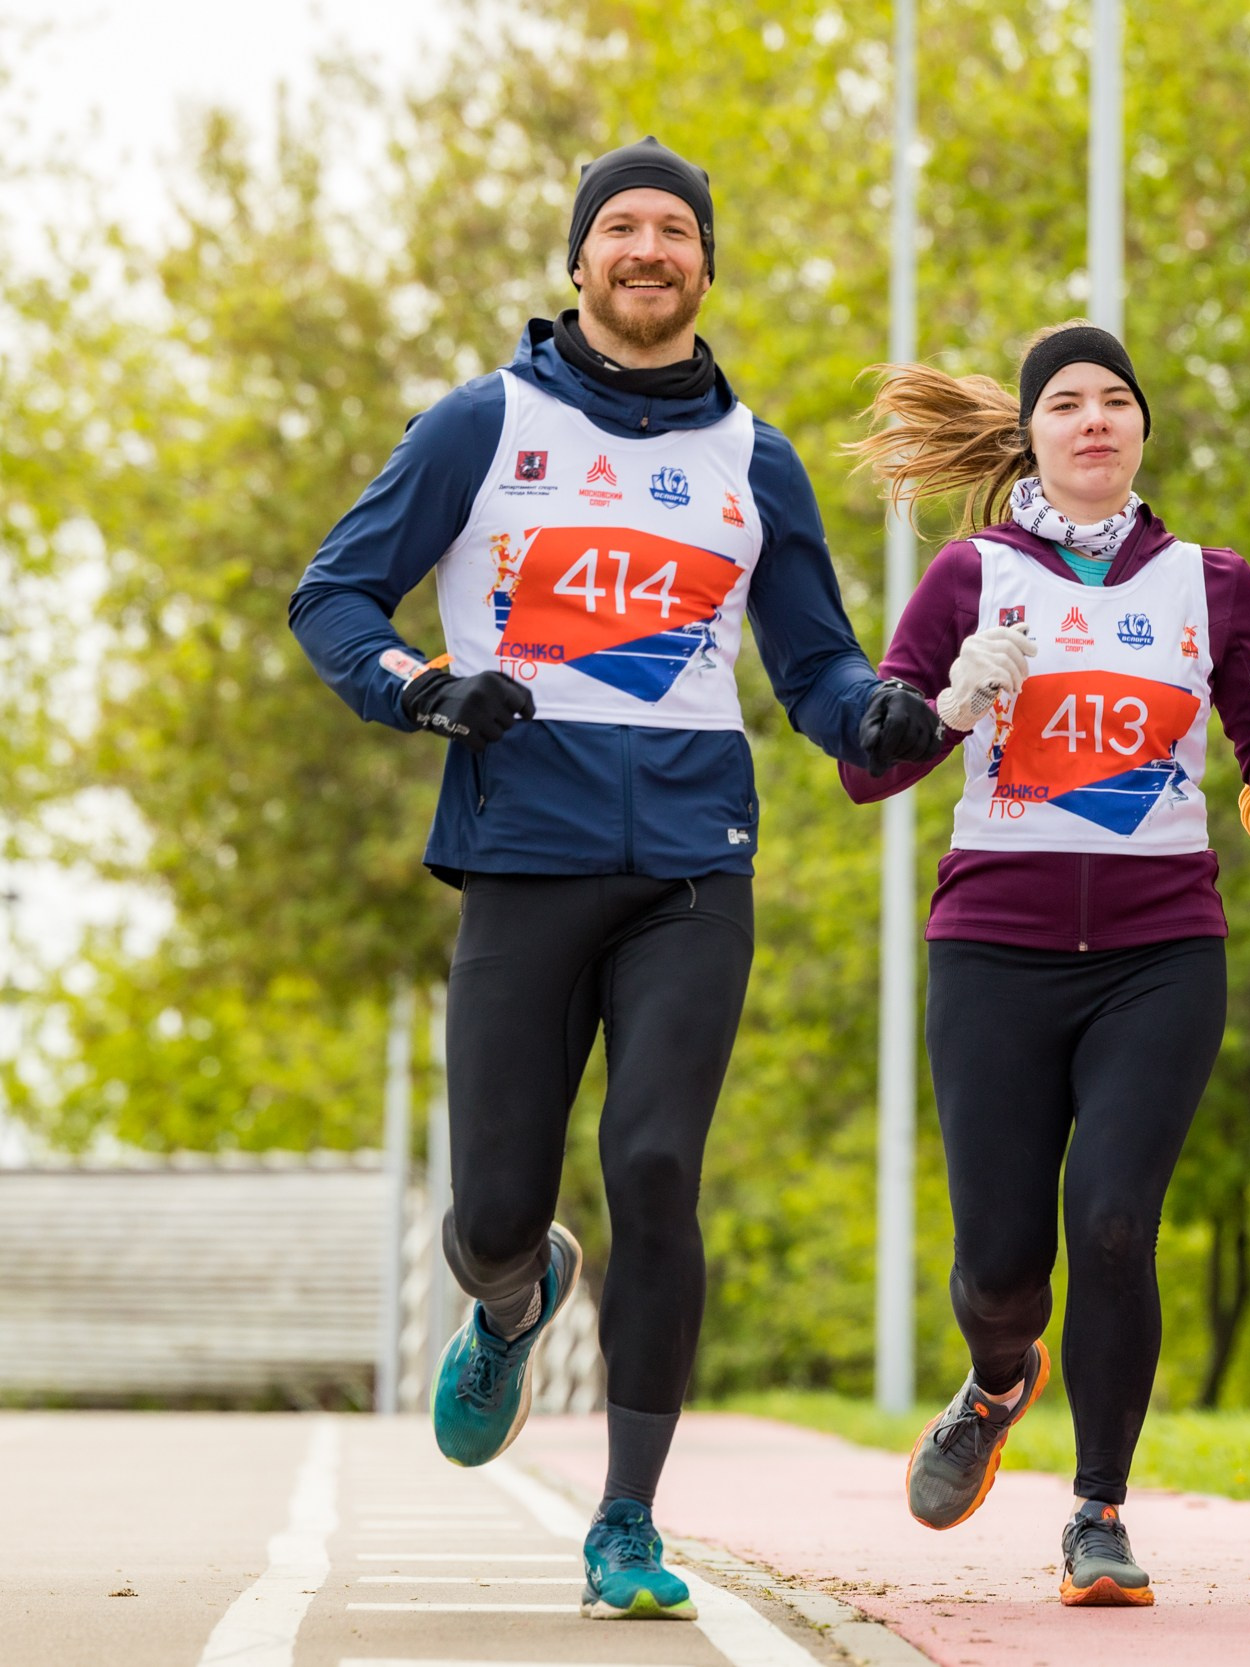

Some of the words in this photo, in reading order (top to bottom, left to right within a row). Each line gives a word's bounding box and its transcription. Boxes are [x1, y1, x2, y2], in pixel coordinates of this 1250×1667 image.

[579, 488, 623, 501] МОСКОВСКИЙ
[553, 548, 681, 618] 414
[1055, 636, 1095, 646] МОСКОВСКИЙ
[500, 659, 538, 681] ГТО
[1041, 694, 1149, 756] 413
[989, 799, 1025, 819] ГТО
